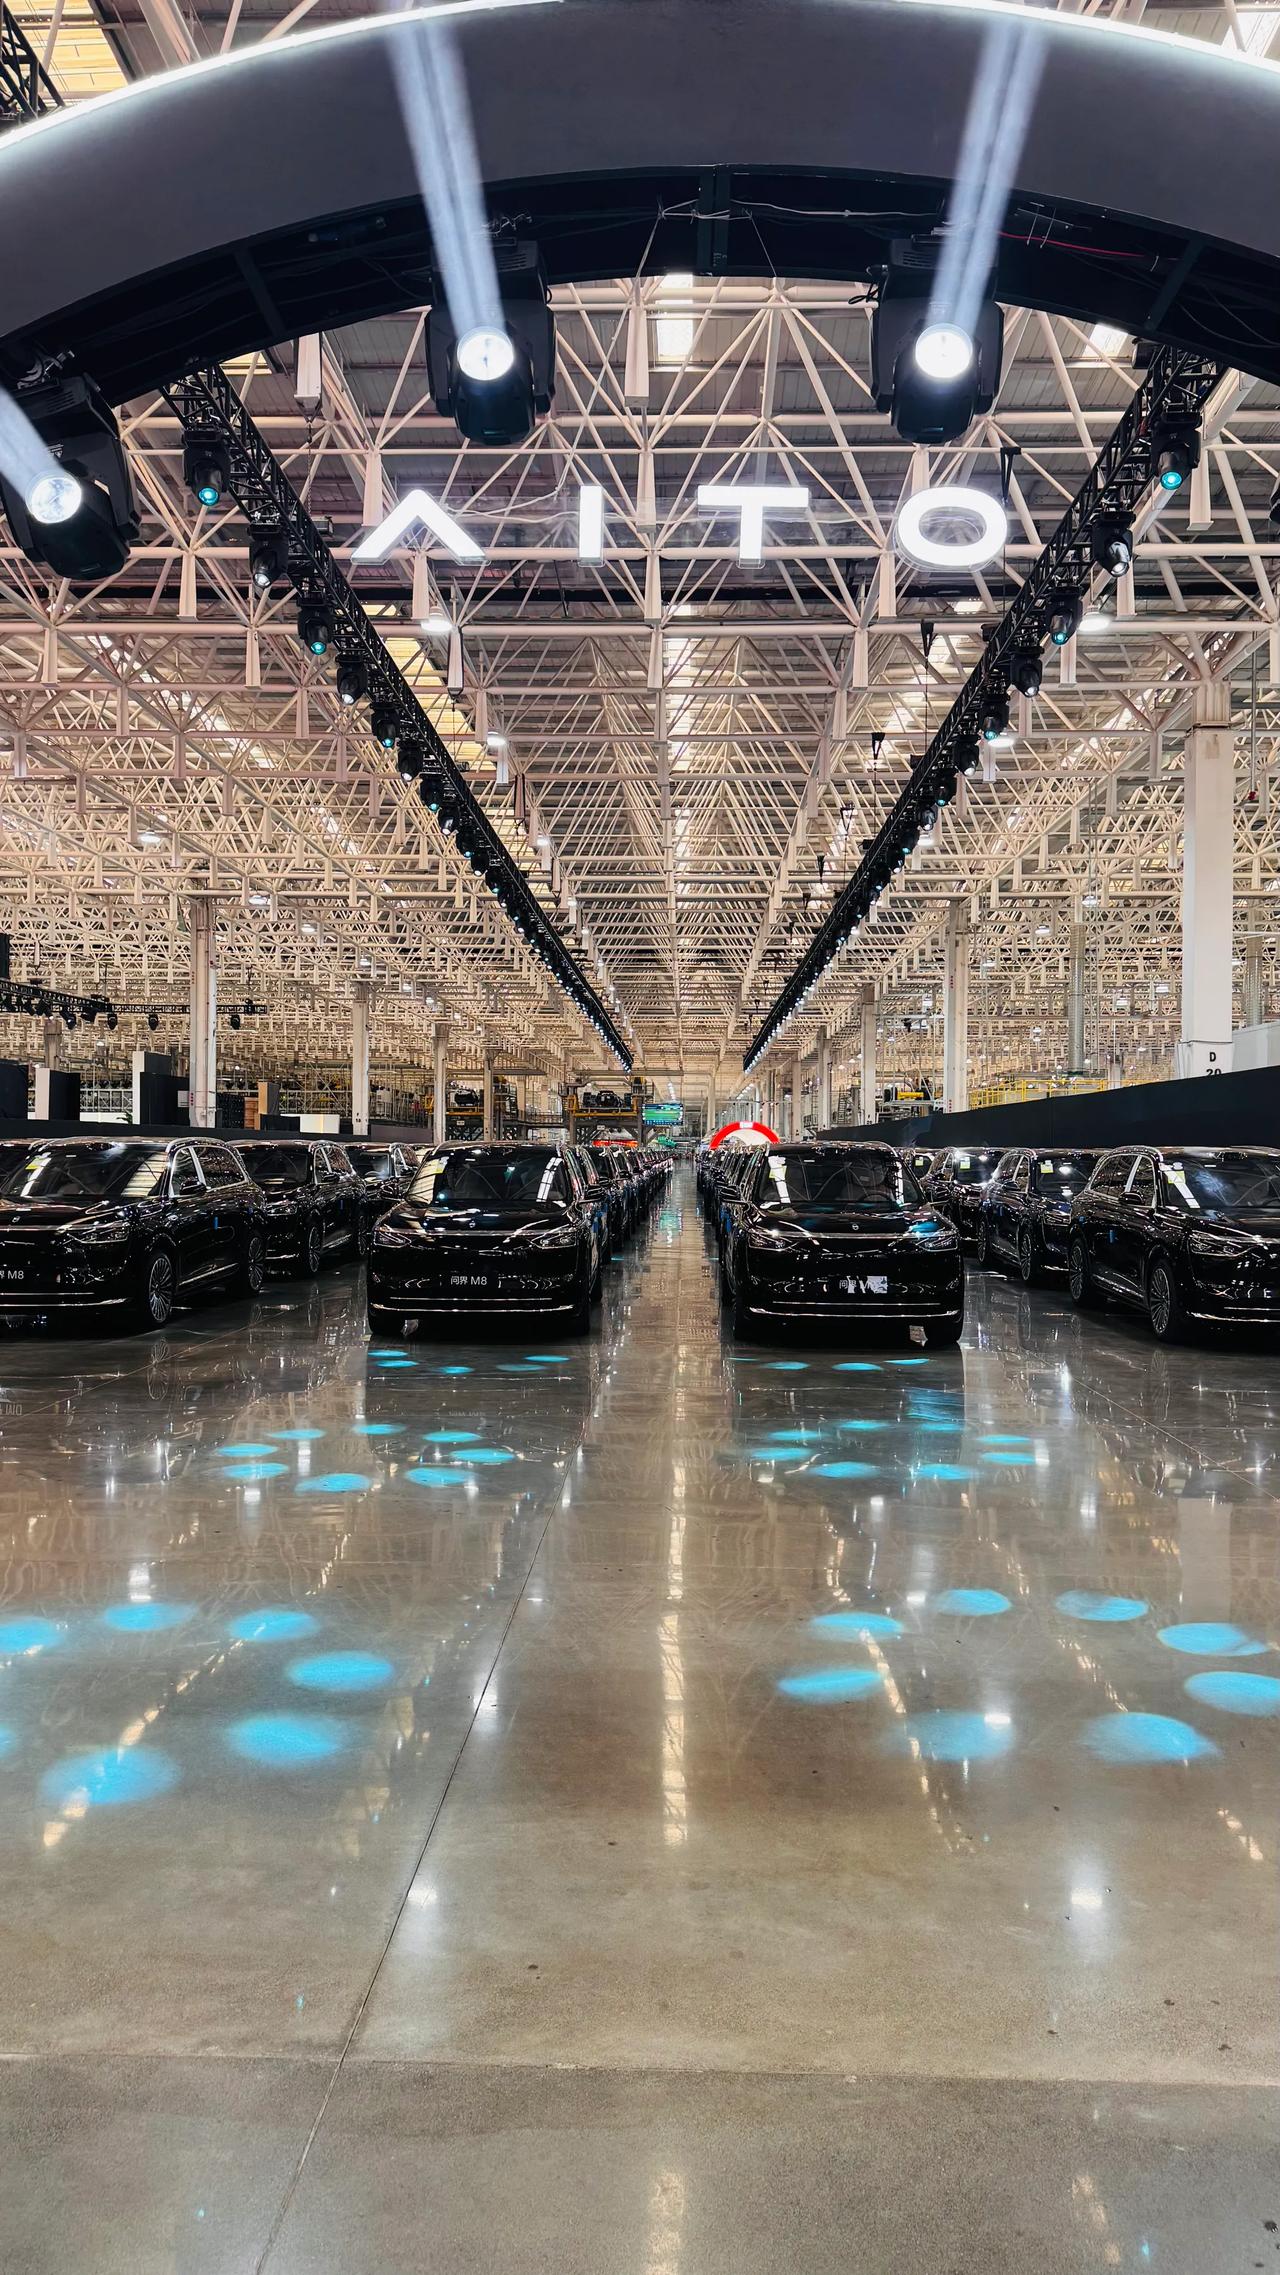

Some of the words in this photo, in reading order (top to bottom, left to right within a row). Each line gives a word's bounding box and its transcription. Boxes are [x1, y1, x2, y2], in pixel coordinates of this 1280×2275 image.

[350, 484, 1009, 567] AITO
[1209, 1051, 1217, 1063] D
[7, 1270, 25, 1280] M8
[450, 1275, 468, 1285] 问界
[470, 1275, 488, 1285] M8
